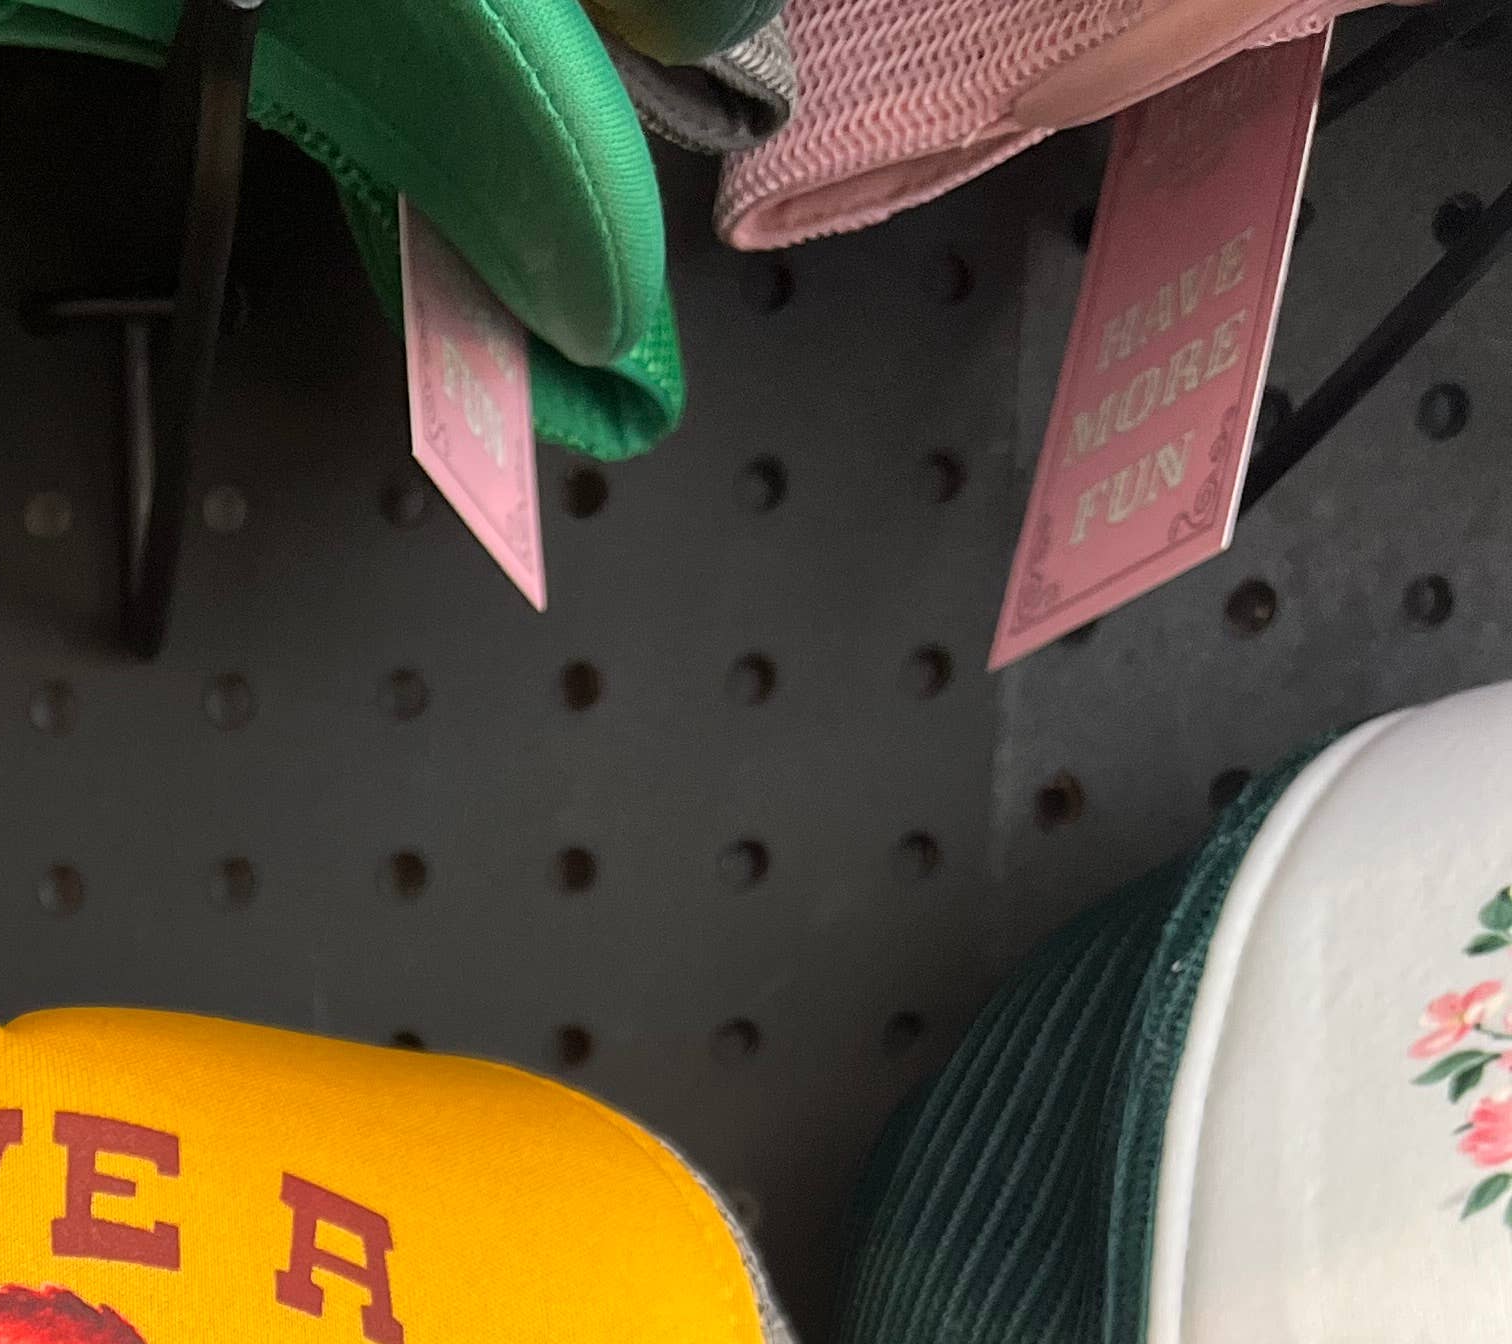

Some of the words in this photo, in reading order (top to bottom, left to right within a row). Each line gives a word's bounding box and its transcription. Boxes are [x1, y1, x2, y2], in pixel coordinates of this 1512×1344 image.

[1096, 228, 1254, 374] HAVE
[1064, 311, 1247, 464] MORE
[1068, 431, 1193, 546] FUN
